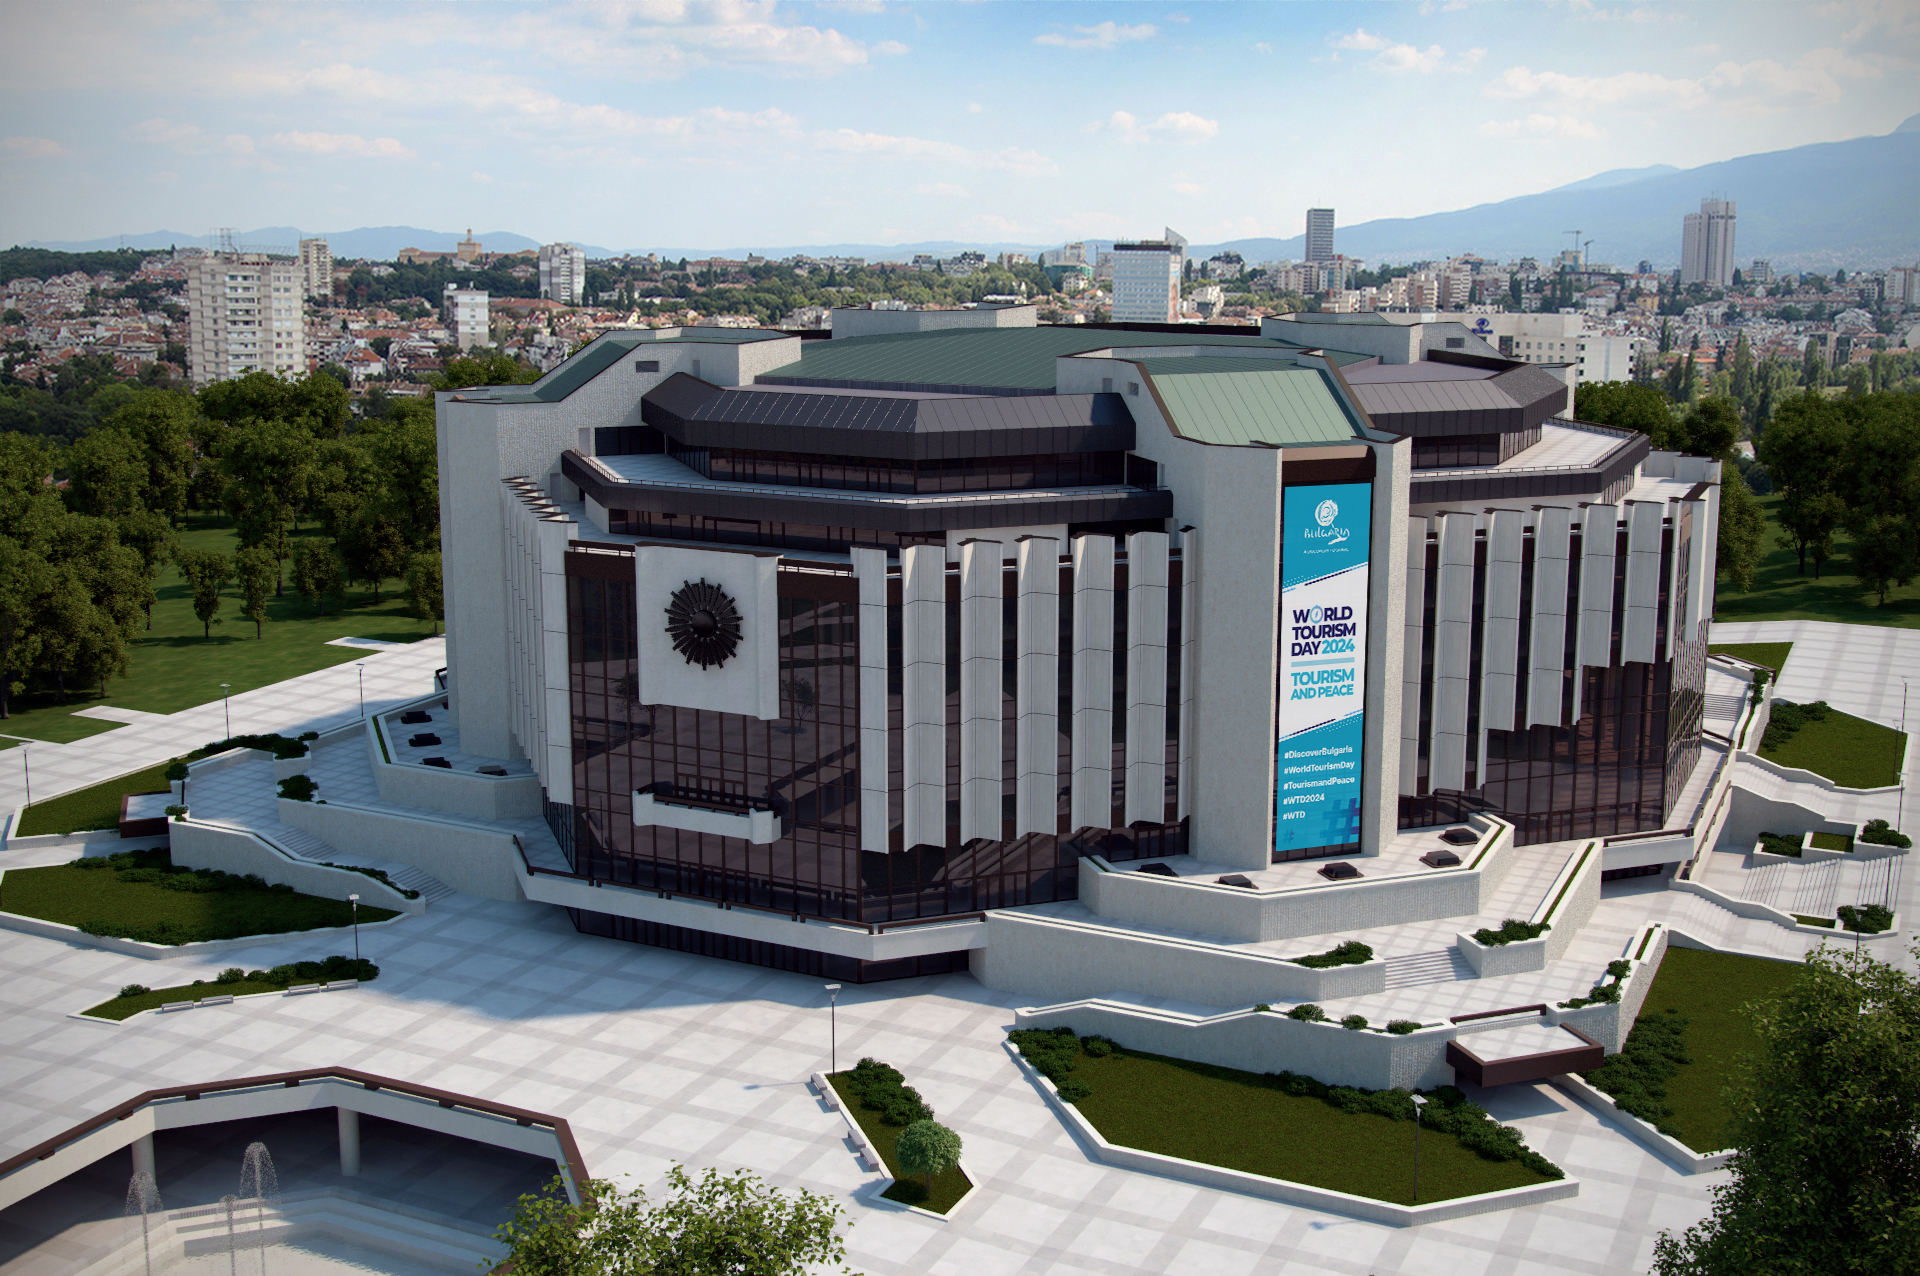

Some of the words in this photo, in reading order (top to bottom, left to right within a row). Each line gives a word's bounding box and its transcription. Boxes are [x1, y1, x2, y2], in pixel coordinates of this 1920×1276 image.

[1292, 605, 1353, 624] WORLD
[1291, 622, 1356, 641] TOURISM
[1291, 641, 1322, 657] DAY
[1321, 638, 1355, 654] 2024
[1290, 668, 1355, 687] TOURISM
[1290, 687, 1317, 701] AND
[1318, 684, 1354, 699] PEACE
[1284, 745, 1353, 759] #DiscoverBulgaria
[1283, 761, 1355, 775] #WorldTourismDay
[1283, 777, 1355, 790] #TourismandPeace
[1283, 793, 1325, 805] #WTD2024
[1282, 811, 1306, 820] #WTD
